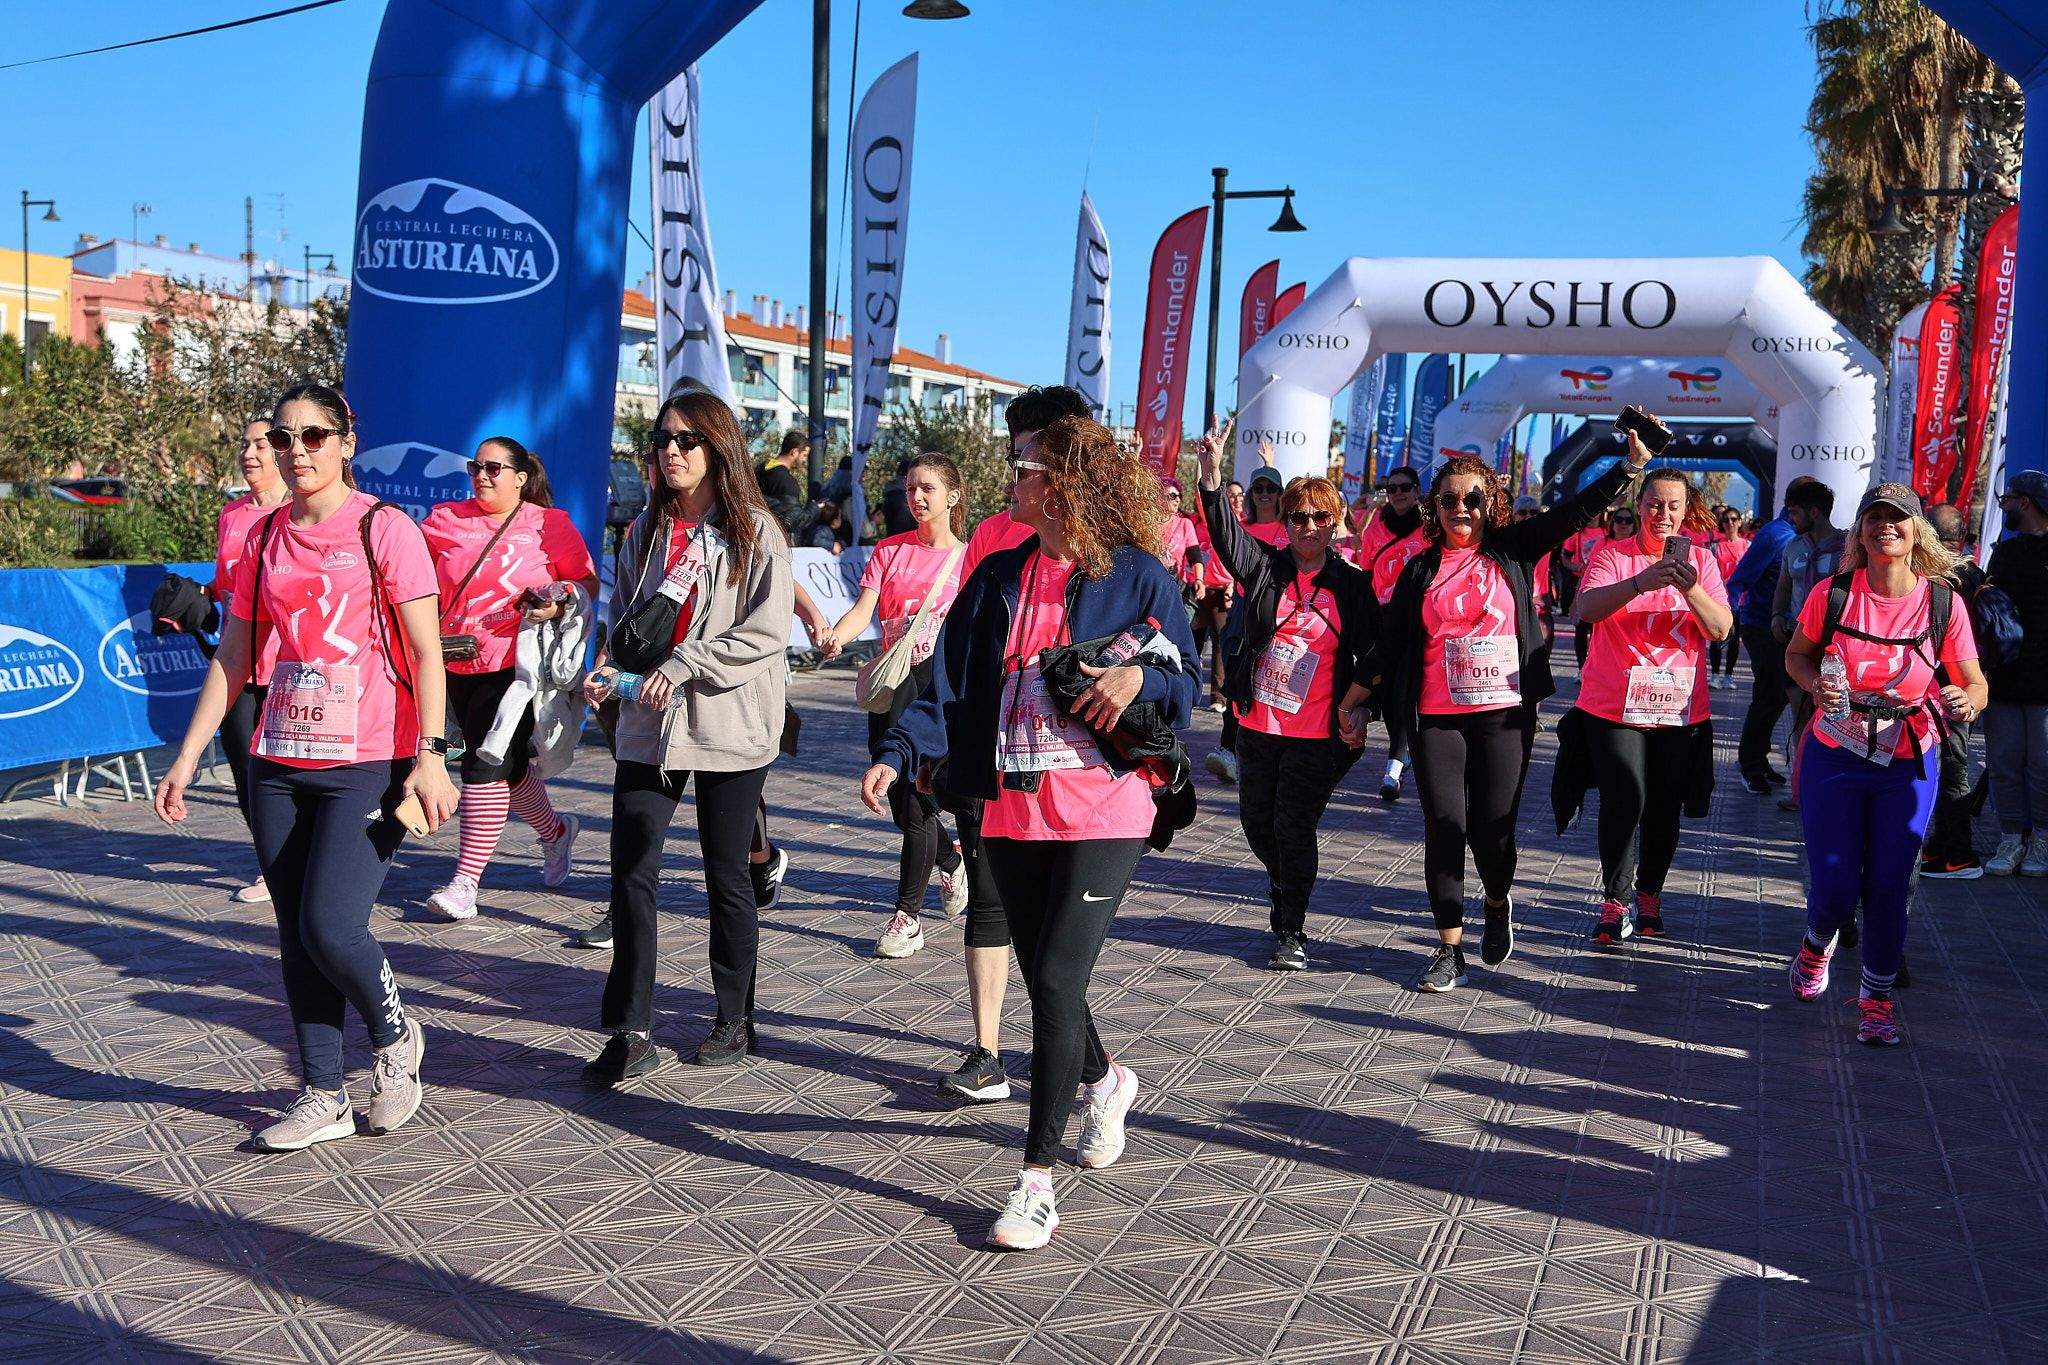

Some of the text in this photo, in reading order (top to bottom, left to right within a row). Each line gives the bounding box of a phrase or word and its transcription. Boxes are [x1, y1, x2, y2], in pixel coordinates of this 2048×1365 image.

[376, 220, 534, 243] CENTRAL LECHERA
[356, 224, 540, 281] ASTURIANA
[1423, 279, 1677, 330] OYSHO
[1157, 251, 1190, 383] Santander
[1278, 333, 1350, 350] OYSHO
[1752, 336, 1832, 353] OYSHO
[1928, 319, 1954, 434] Santander
[1559, 393, 1613, 402] TotalEnergies
[1666, 394, 1722, 403] TotalEnergies
[1242, 429, 1306, 446] OYSHO
[1611, 434, 1728, 447] VVO
[1791, 444, 1866, 461] OYSHO
[429, 487, 475, 500] LECH
[675, 569, 692, 582] 7270
[912, 642, 931, 653] 16
[4, 649, 61, 663] LECHERA
[1264, 667, 1290, 684] 016
[1472, 666, 1499, 678] 016
[1649, 692, 1673, 702] 016
[288, 704, 324, 721] 016
[292, 724, 311, 733] 7269
[1031, 714, 1068, 730] 016
[311, 746, 344, 755] Santander
